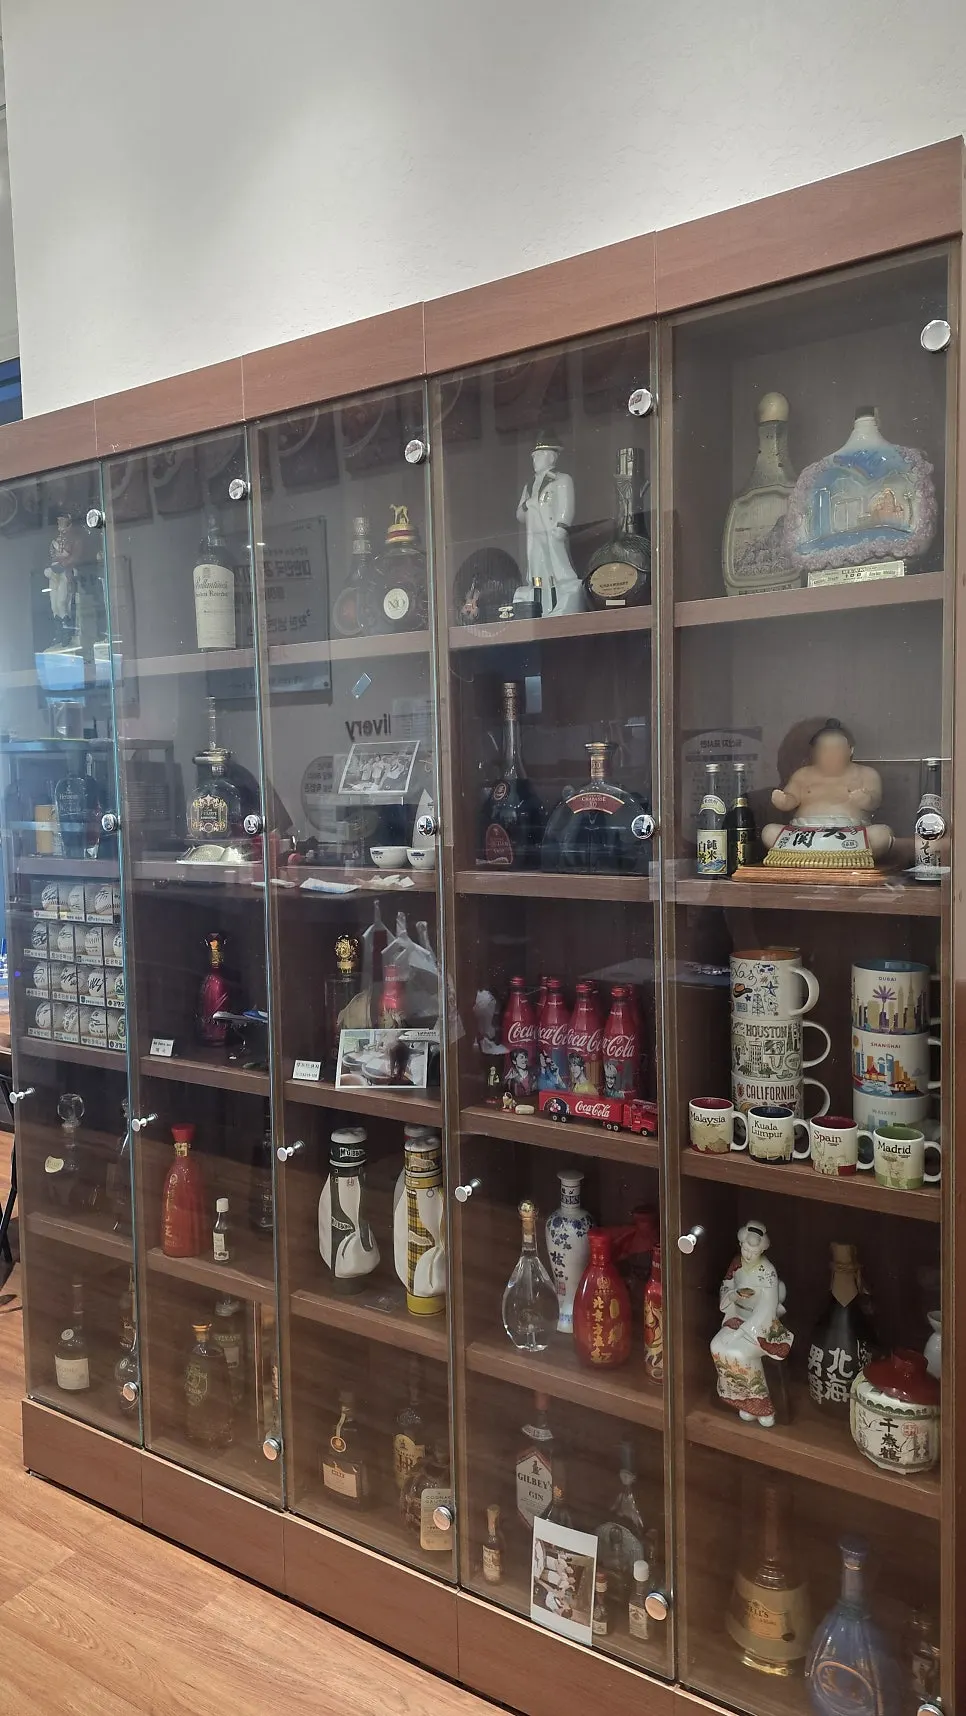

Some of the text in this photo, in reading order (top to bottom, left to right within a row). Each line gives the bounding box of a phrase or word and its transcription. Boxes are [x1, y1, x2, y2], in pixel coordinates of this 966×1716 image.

[745, 1023, 788, 1039] HOUSTON
[745, 1084, 796, 1100] CALIFORNIA
[575, 1101, 611, 1118] Coca-Cola
[690, 1110, 726, 1126] Malaysia
[751, 1126, 783, 1139] Lumpur
[754, 1120, 778, 1131] Kuala
[813, 1131, 842, 1144] Spain
[877, 1141, 912, 1154] Madrid
[517, 1472, 553, 1490] GILBEY'S
[528, 1491, 544, 1502] GIN
